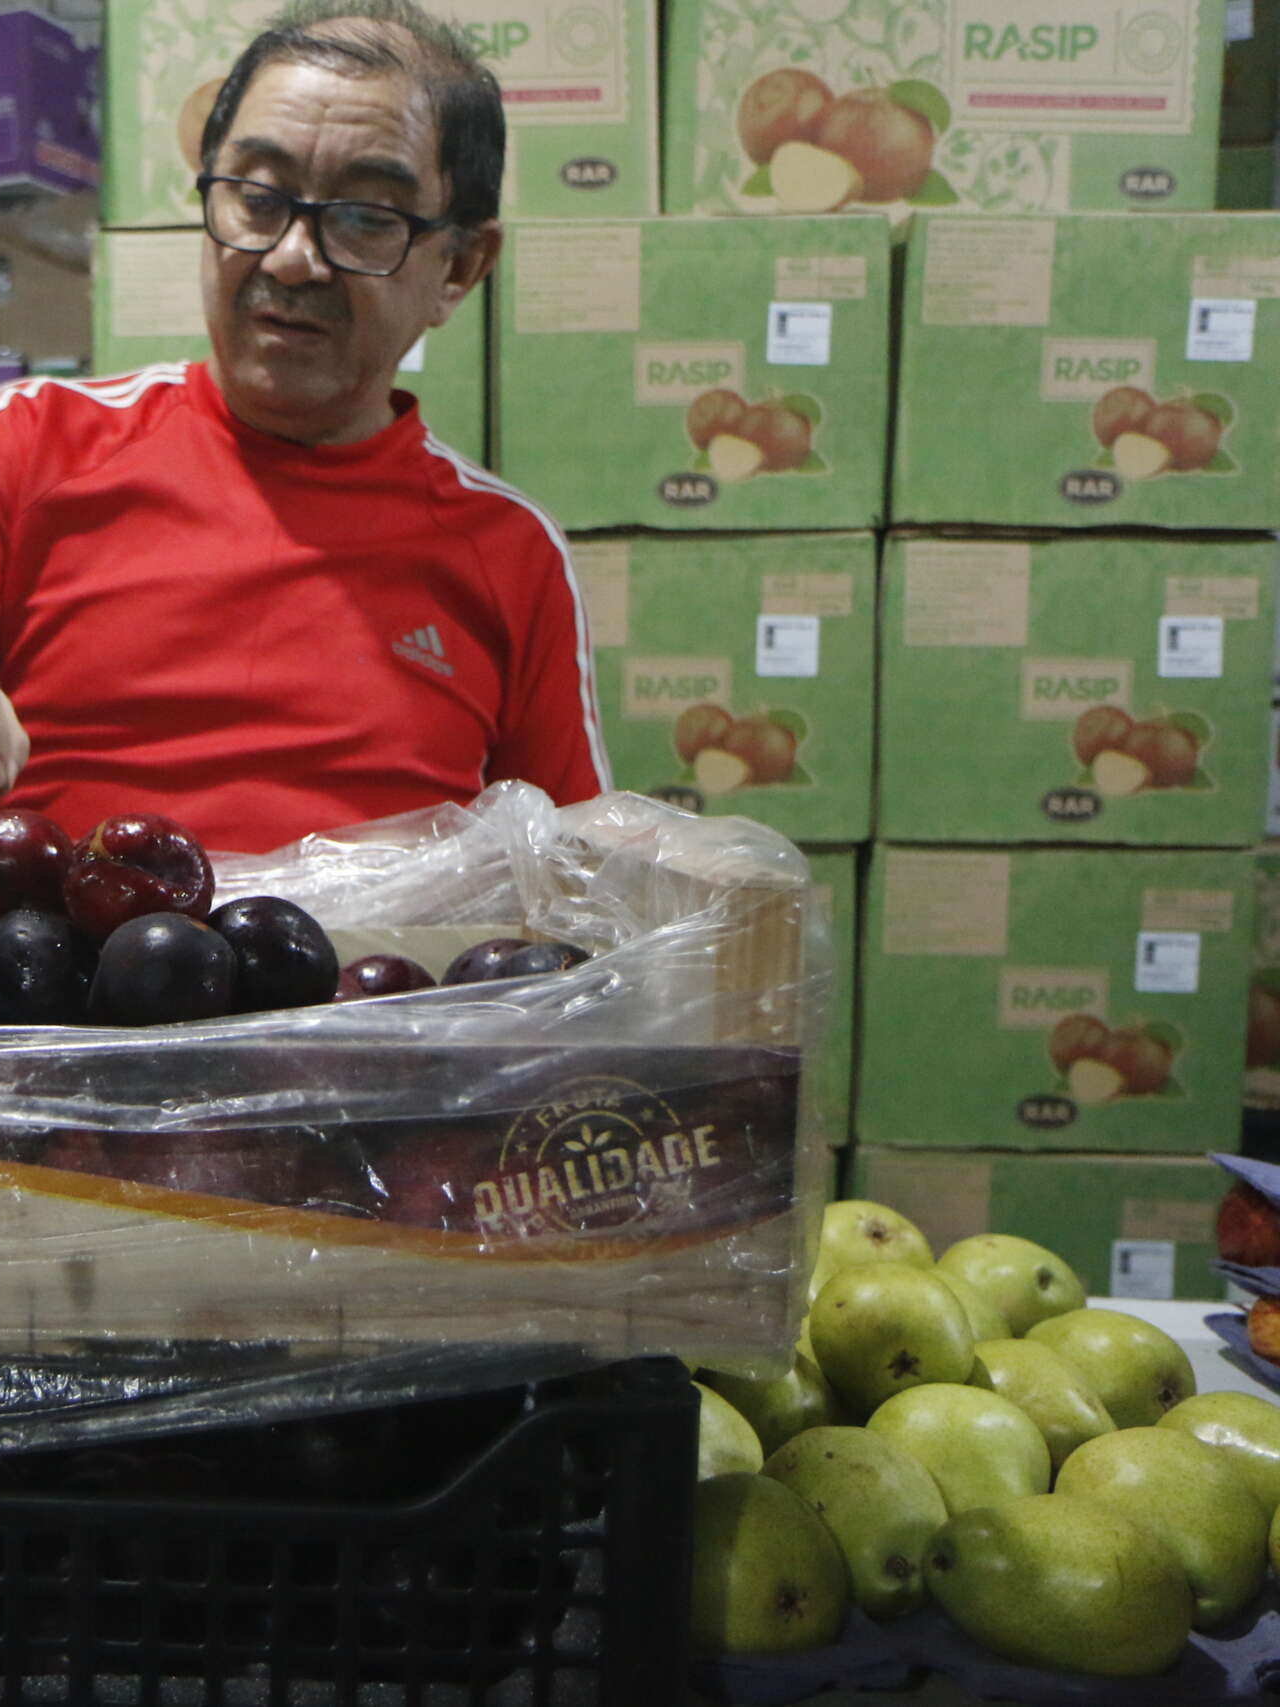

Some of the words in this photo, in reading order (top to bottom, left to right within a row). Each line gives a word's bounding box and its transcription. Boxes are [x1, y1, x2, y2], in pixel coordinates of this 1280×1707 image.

[963, 21, 1100, 62] RASIP
[565, 164, 612, 181] RAR
[646, 358, 733, 387] RASIP
[1053, 355, 1141, 382] RASIP
[662, 480, 712, 500] RAR
[1064, 476, 1115, 498] RAR
[634, 673, 719, 700] RASIP
[1032, 674, 1121, 701] RASIP
[472, 1123, 721, 1223] QUALIDADE
